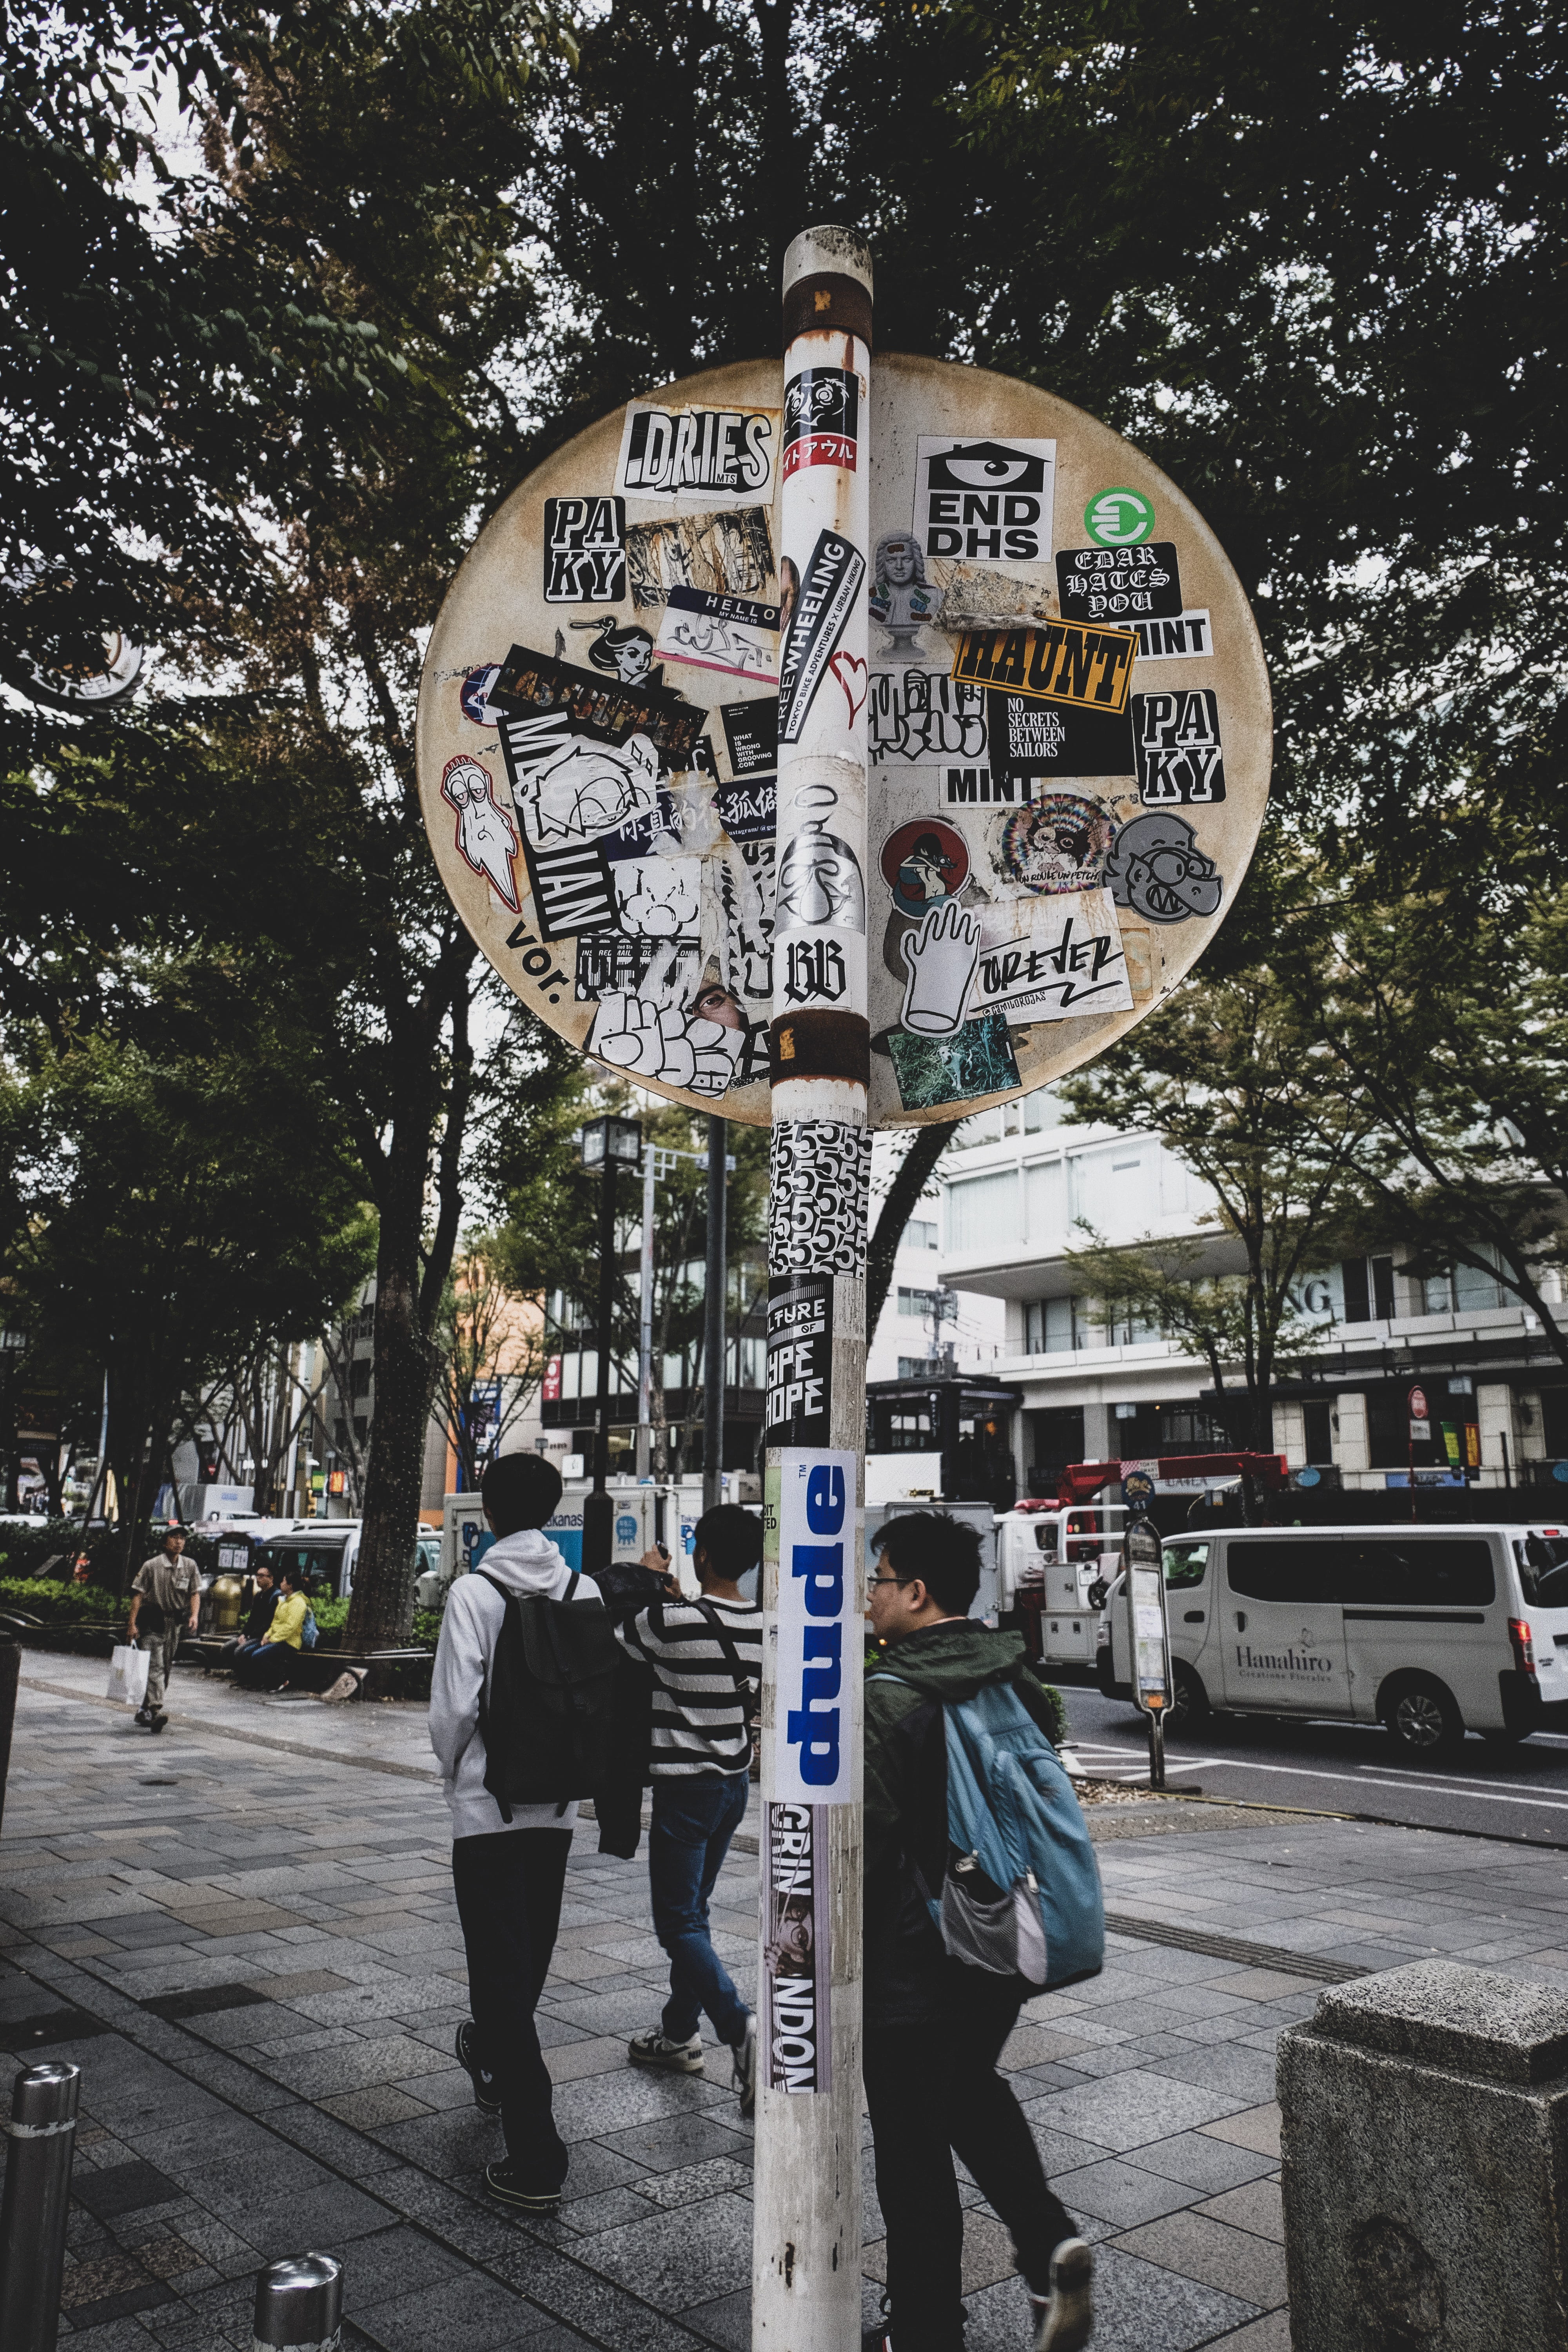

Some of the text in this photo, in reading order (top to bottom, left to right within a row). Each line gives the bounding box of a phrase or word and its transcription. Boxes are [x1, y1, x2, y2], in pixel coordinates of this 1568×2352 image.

[624, 411, 773, 494] DRIES
[716, 473, 736, 484] MTS
[550, 498, 620, 548] PA
[928, 493, 1041, 526] END
[927, 527, 1039, 560] DHS
[1074, 546, 1158, 570] EDAR
[546, 549, 626, 601] KY
[1065, 568, 1170, 597] HATES
[706, 595, 775, 621] HELLO
[730, 614, 749, 622] NAME
[1088, 591, 1154, 618] YOU
[778, 543, 845, 734] FREEWHEELING
[789, 700, 803, 732] TOKYO
[799, 677, 812, 697] BIKE
[808, 621, 836, 675] ADVENTURES
[835, 585, 851, 612] URBAN
[846, 559, 861, 586] HIKING
[960, 626, 1132, 704] HAUNT
[1007, 697, 1024, 713] NO
[1008, 711, 1059, 728] SECRETS
[1142, 691, 1214, 748] PA
[733, 733, 752, 741] WHAT
[735, 743, 760, 752] WRONG
[1009, 727, 1065, 743] BETWEEN
[737, 752, 772, 762] GROOVING
[1010, 742, 1058, 758] SAILORS
[1143, 745, 1222, 804] KY
[769, 1298, 825, 1333] LTURE
[801, 1323, 816, 1333] OF
[787, 1465, 846, 1786] dude
[1236, 1646, 1332, 1672] Hanahiro
